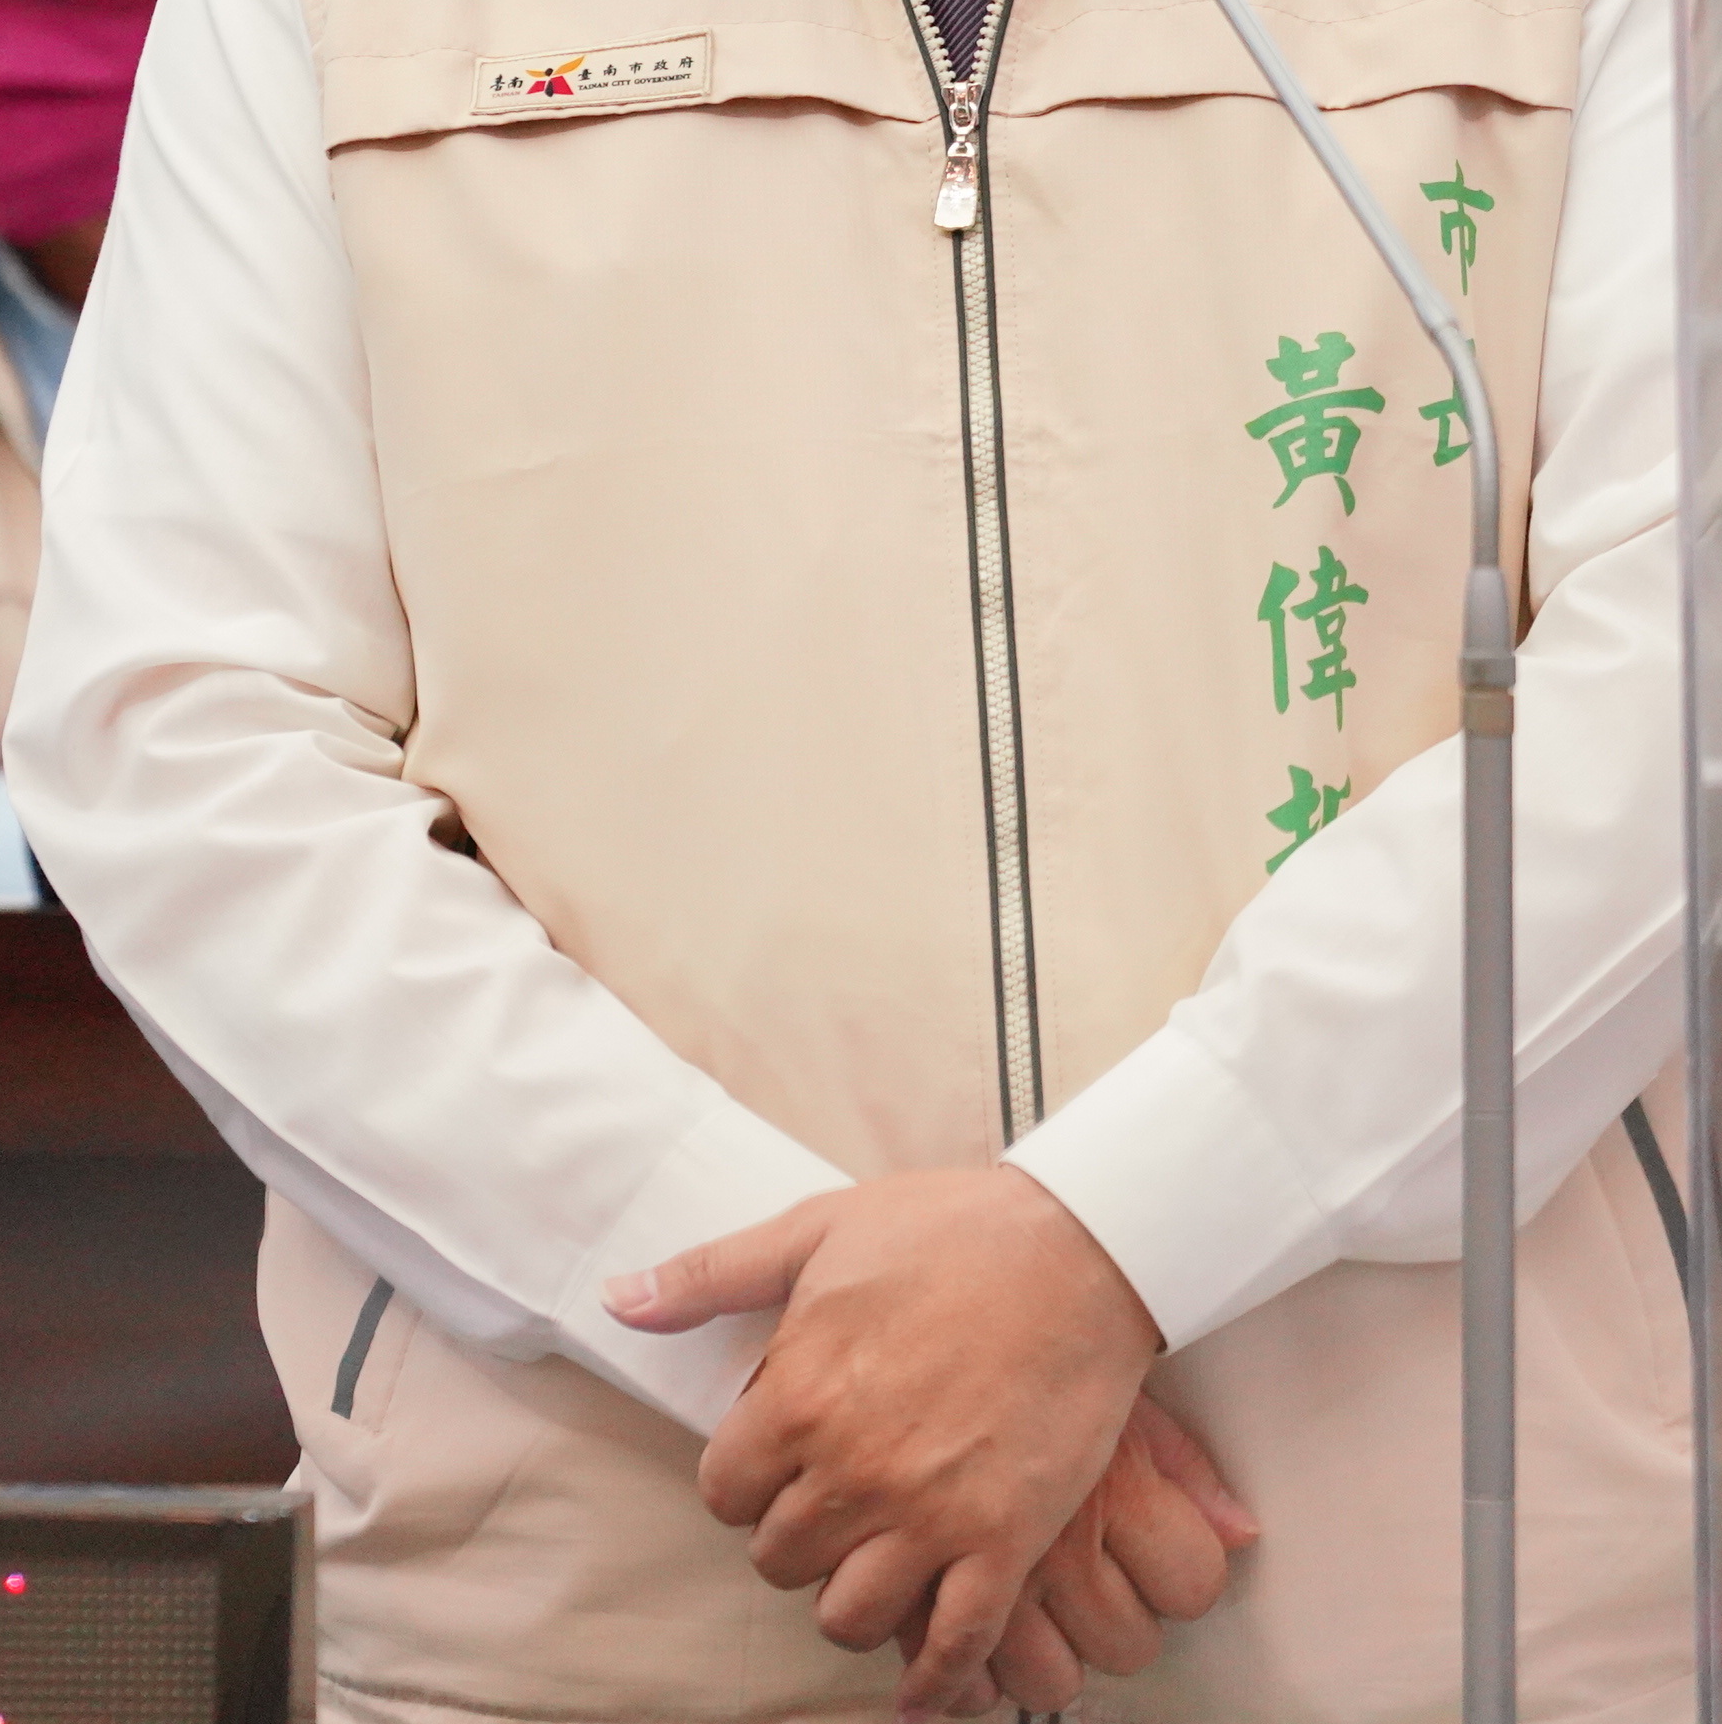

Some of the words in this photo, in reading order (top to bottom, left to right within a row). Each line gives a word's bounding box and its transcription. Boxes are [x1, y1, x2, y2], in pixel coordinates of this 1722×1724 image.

[578, 56, 694, 81] 臺南市政府
[578, 82, 609, 91] TAINAN
[612, 79, 631, 87] CITY
[634, 73, 692, 85] GOVERNMENT
